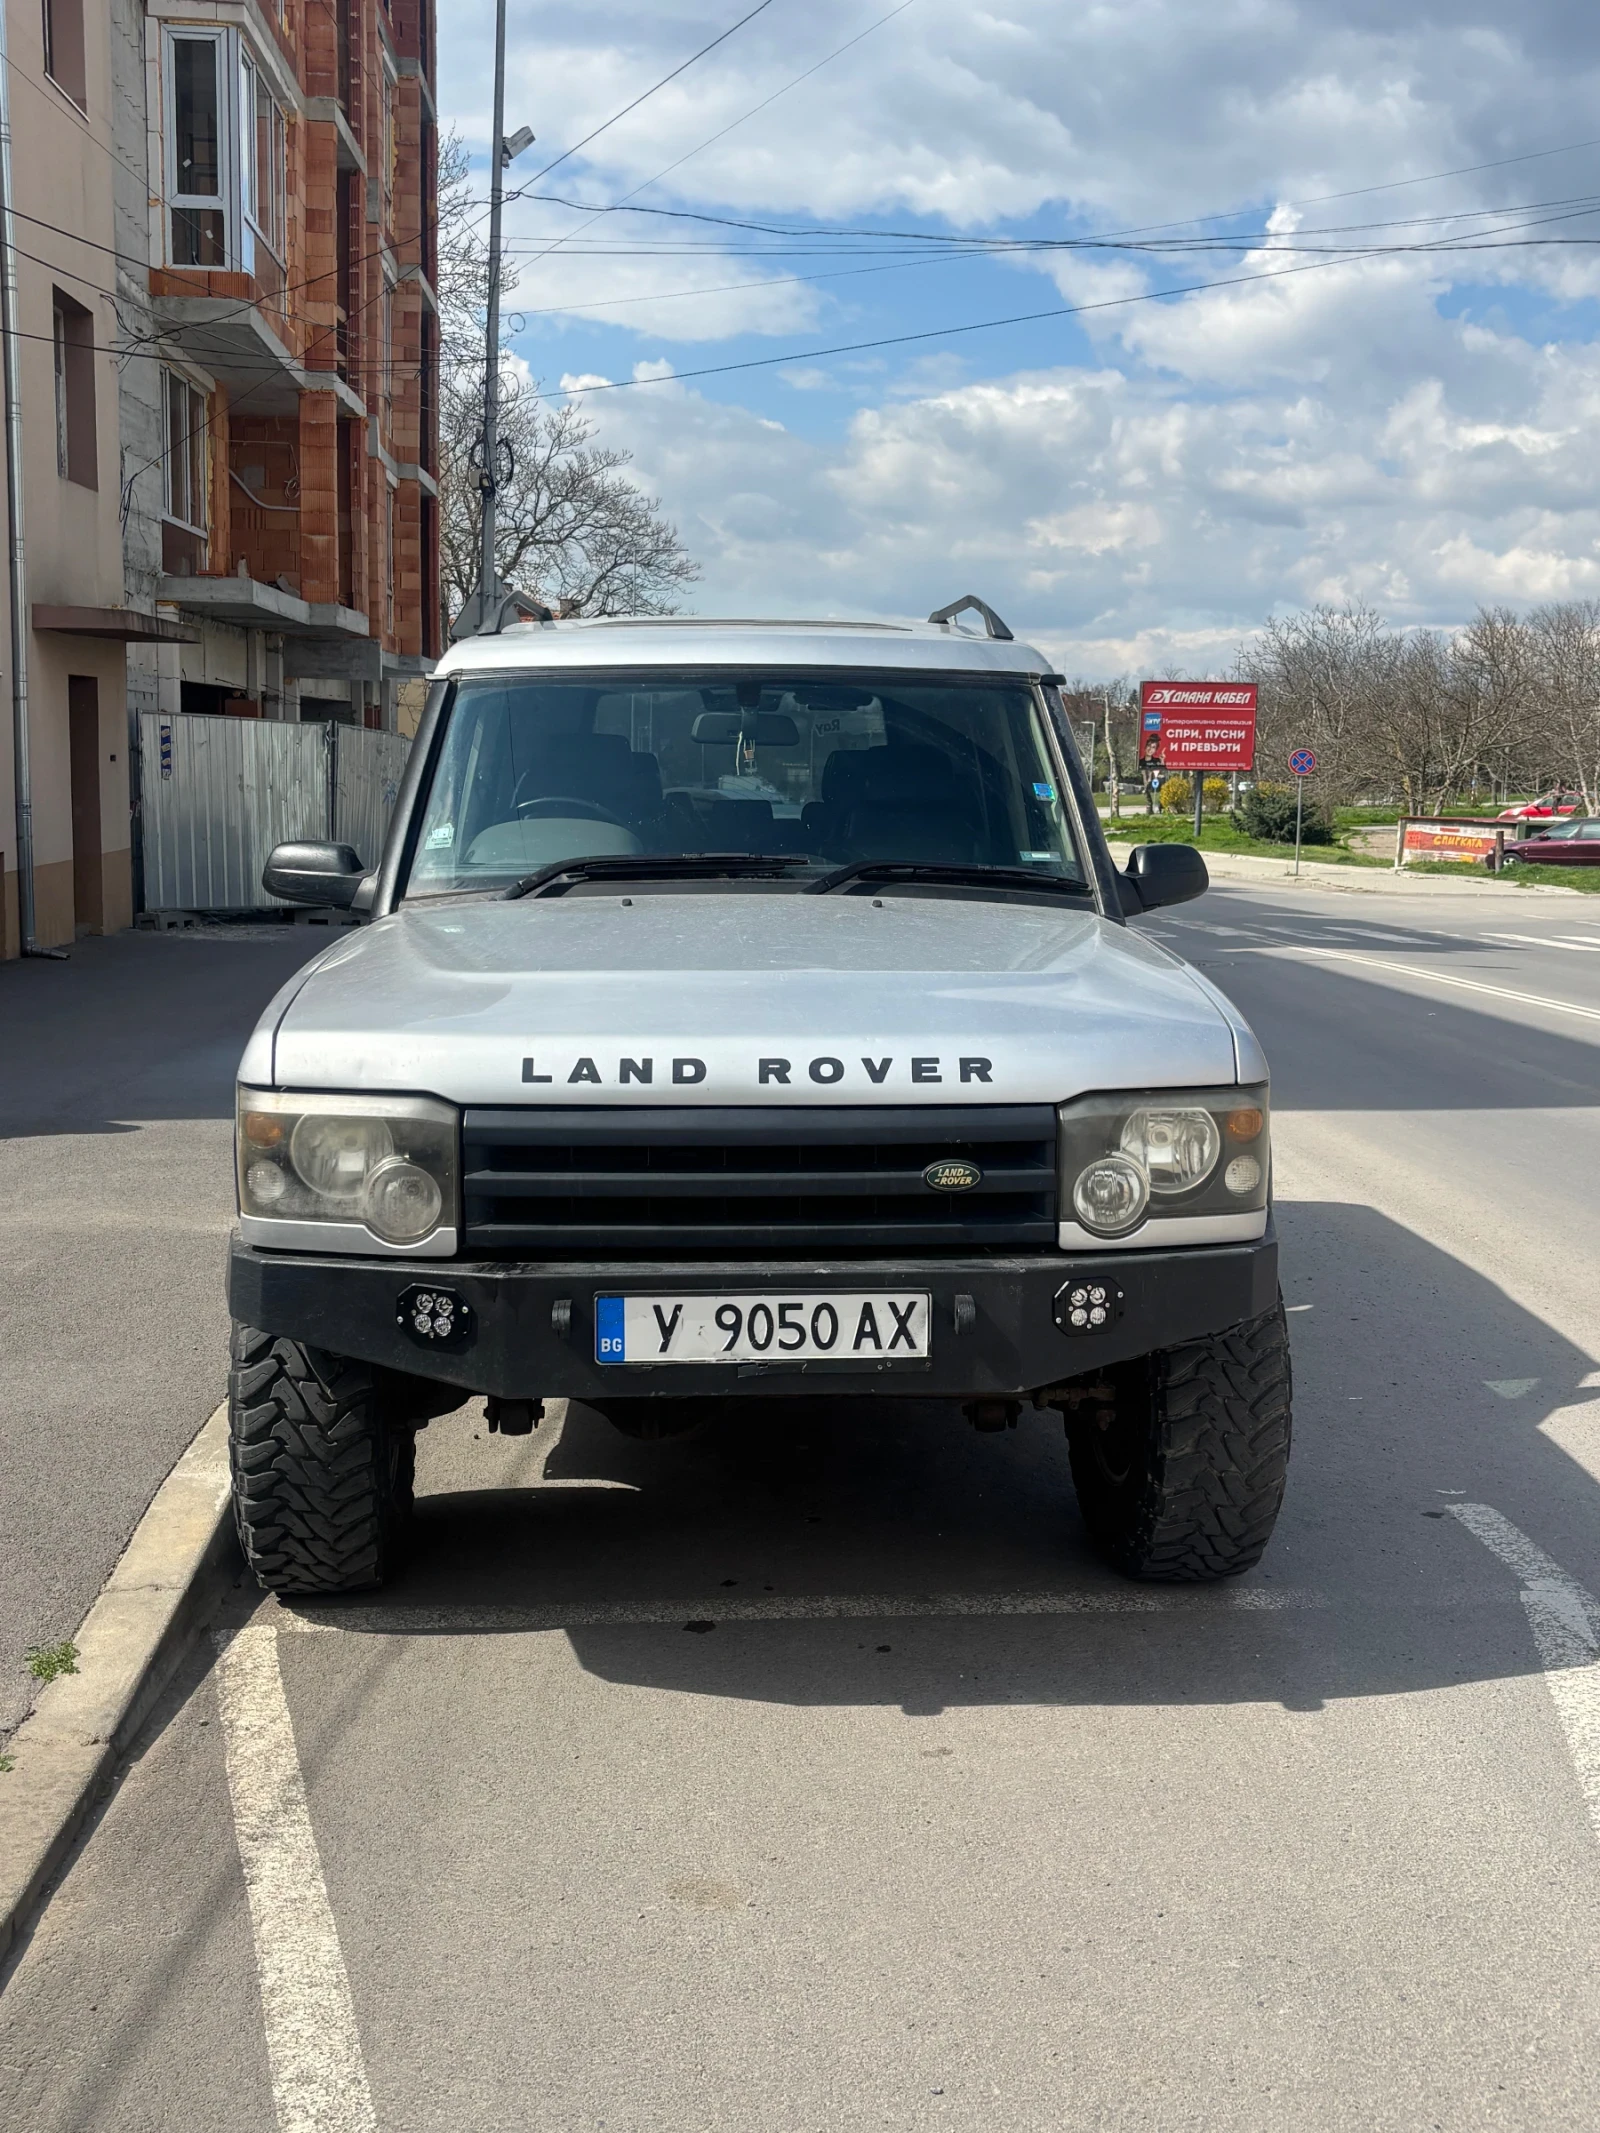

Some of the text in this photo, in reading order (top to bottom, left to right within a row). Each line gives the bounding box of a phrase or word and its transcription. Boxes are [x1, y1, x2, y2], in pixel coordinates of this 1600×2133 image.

[1171, 691, 1251, 704] ДИАНА КАБЕЛ
[1166, 729, 1246, 739] СПРИ, ПУСНИ
[1170, 742, 1241, 752] И ПРЕВЪРТИ
[521, 1057, 993, 1084] LAND ROVER
[937, 1168, 964, 1177] LAND
[940, 1176, 973, 1185] ROVER
[715, 1303, 838, 1352] 9050
[852, 1301, 917, 1350] AX
[601, 1338, 621, 1353] BG
